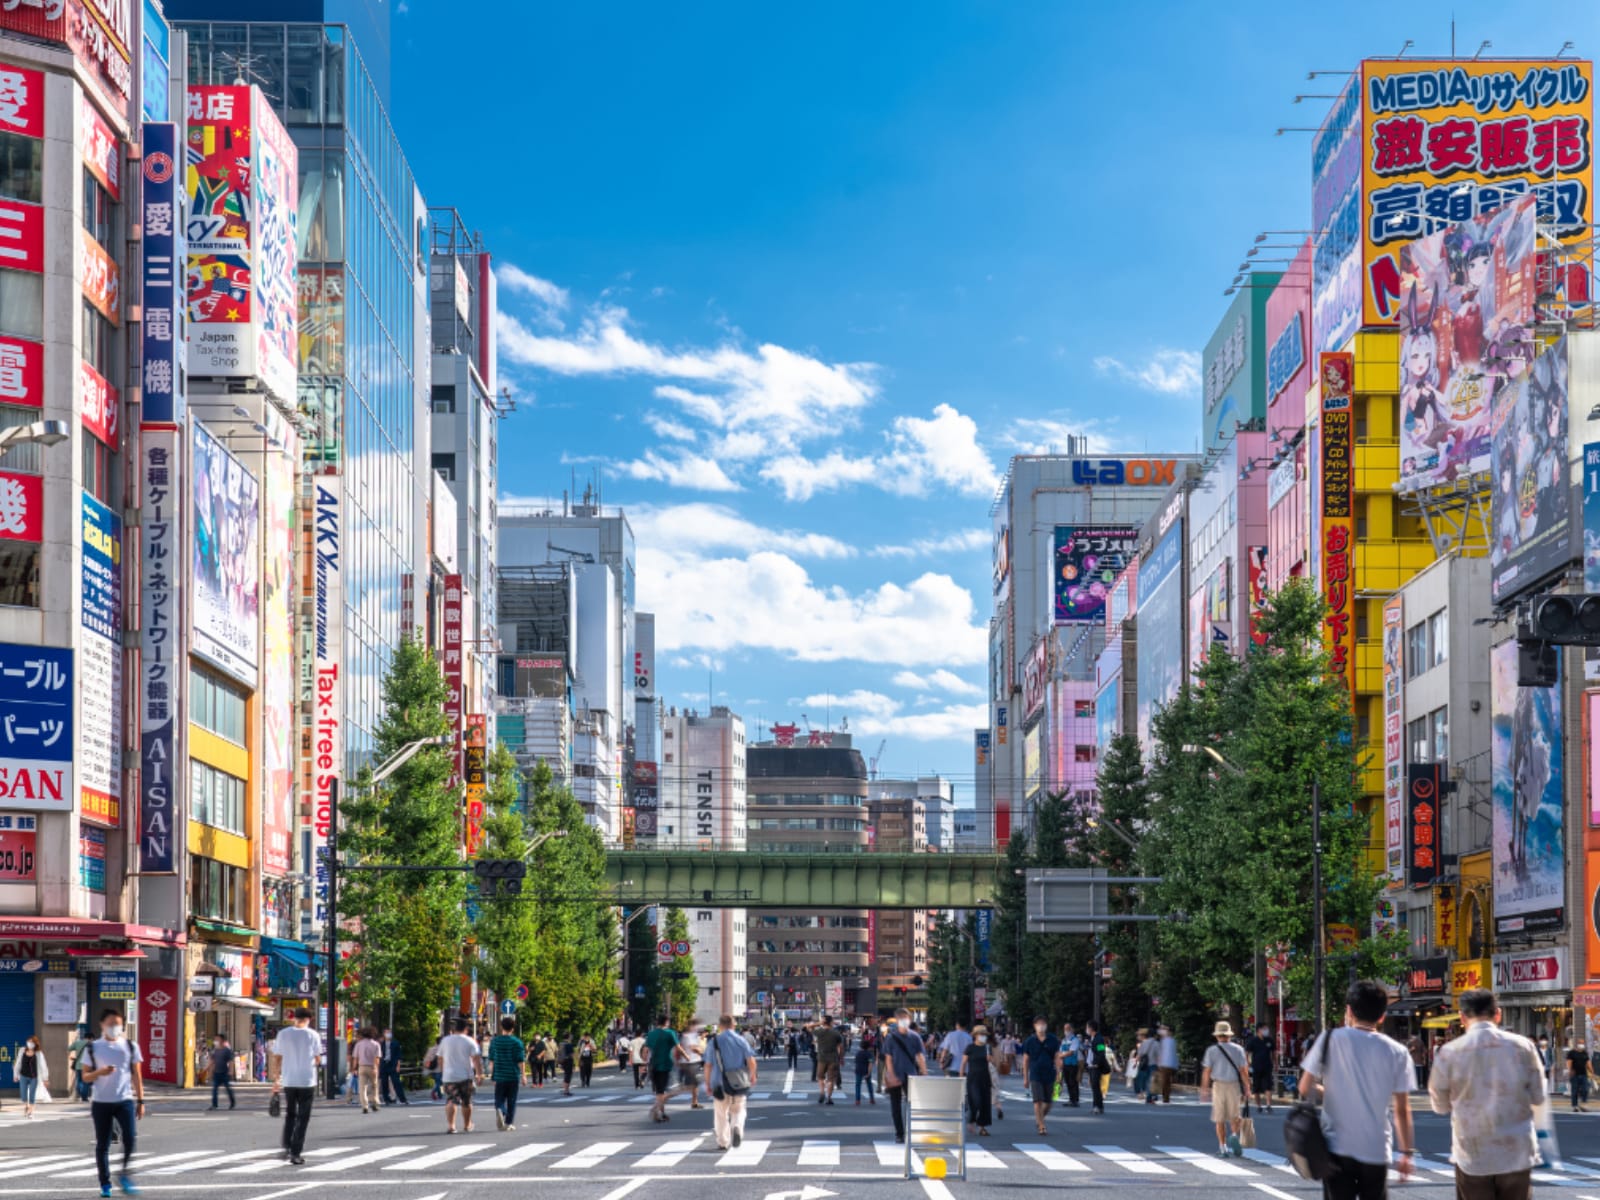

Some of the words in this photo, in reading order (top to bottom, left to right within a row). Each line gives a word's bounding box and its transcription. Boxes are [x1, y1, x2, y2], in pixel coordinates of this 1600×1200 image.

[1370, 67, 1586, 112] MEDIAリサイクル
[1374, 117, 1583, 173] 激安販売
[145, 202, 173, 394] 愛三電機
[195, 344, 238, 354] Tax-free
[200, 332, 237, 344] Japan.
[211, 356, 238, 368] Shop
[1325, 413, 1347, 424] DVD
[316, 485, 338, 571] AKKY
[147, 447, 169, 720] 各種ケーブル・ネットワーク機器
[316, 549, 327, 660] INTERNATIONAL
[0, 659, 66, 690] ーブル
[318, 664, 338, 769] Tax-free
[147, 737, 168, 859] AISAN
[315, 775, 338, 837] Shop
[0, 923, 80, 933] p://www.aisan.co.jp
[150, 1010, 166, 1074] 坂口電熱
